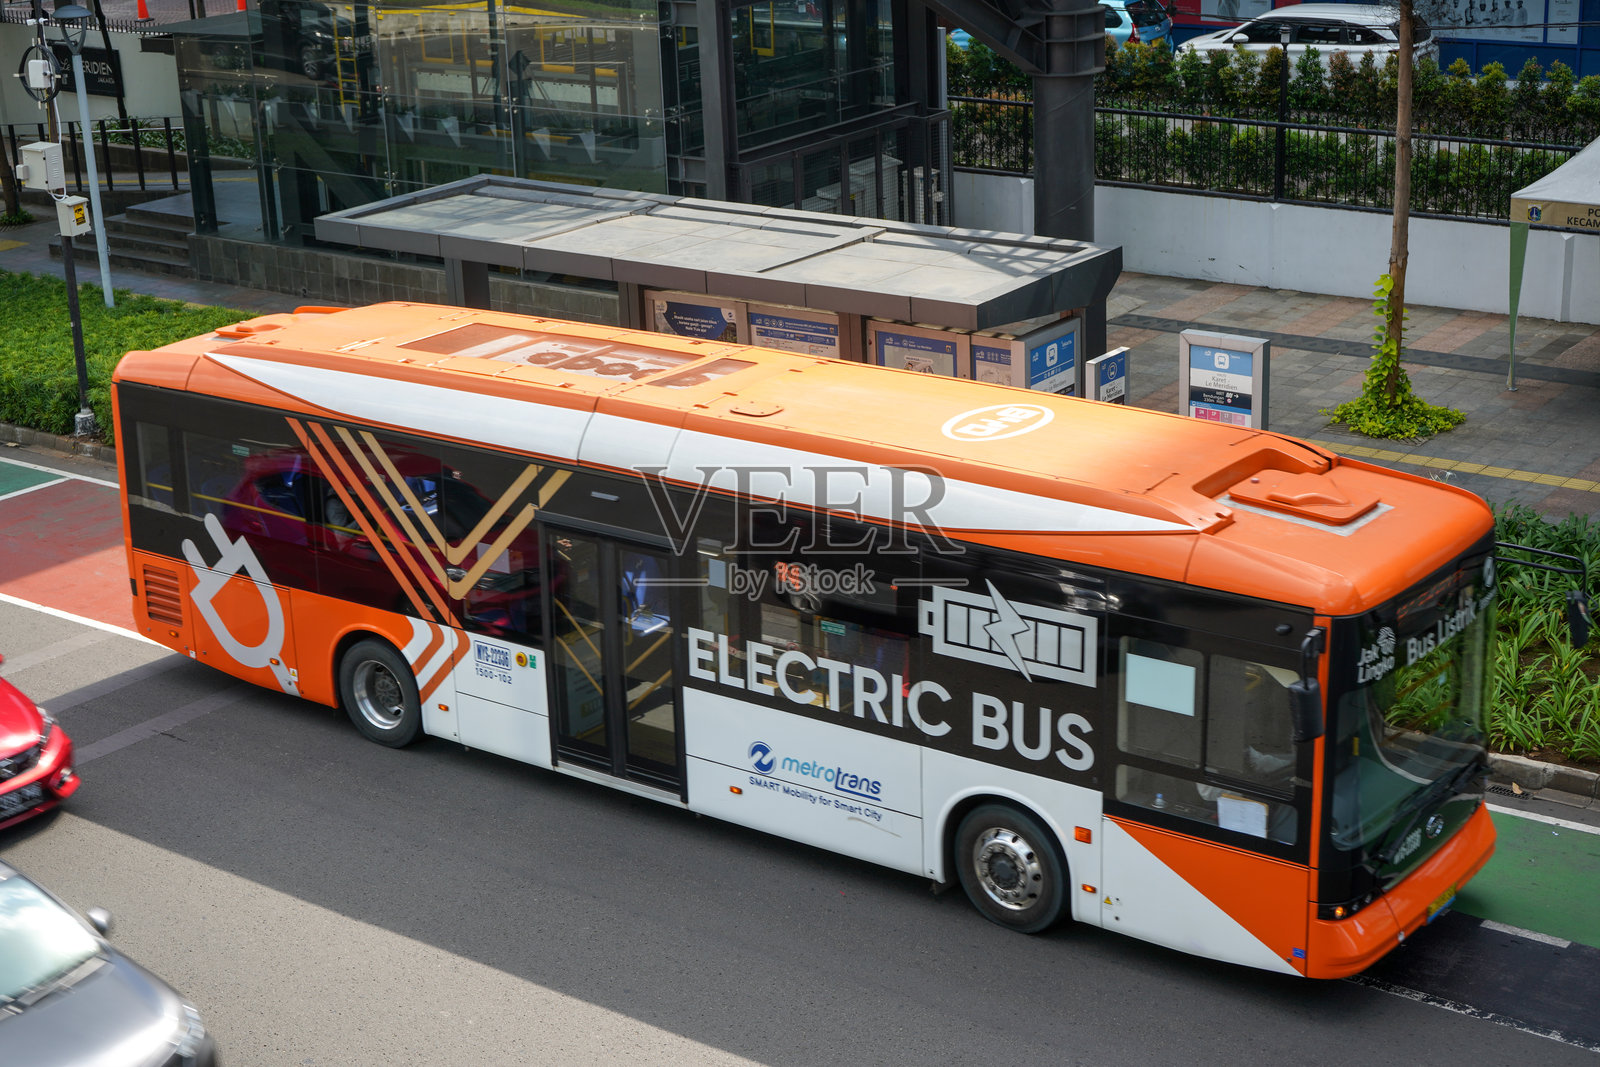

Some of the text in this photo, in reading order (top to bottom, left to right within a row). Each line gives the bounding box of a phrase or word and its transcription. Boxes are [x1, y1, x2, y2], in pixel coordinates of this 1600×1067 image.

[82, 60, 113, 75] ERIDIEN
[1407, 633, 1435, 667] Bus
[1438, 597, 1477, 646] Listrik
[1357, 643, 1379, 667] Jak
[1357, 656, 1395, 684] Lingko
[475, 667, 512, 684] 1500-102
[688, 626, 952, 737] ELECTRIC
[972, 691, 1095, 772] BUS
[781, 757, 882, 801] metrotrans
[749, 776, 883, 821] SMART Mobility for Smart City
